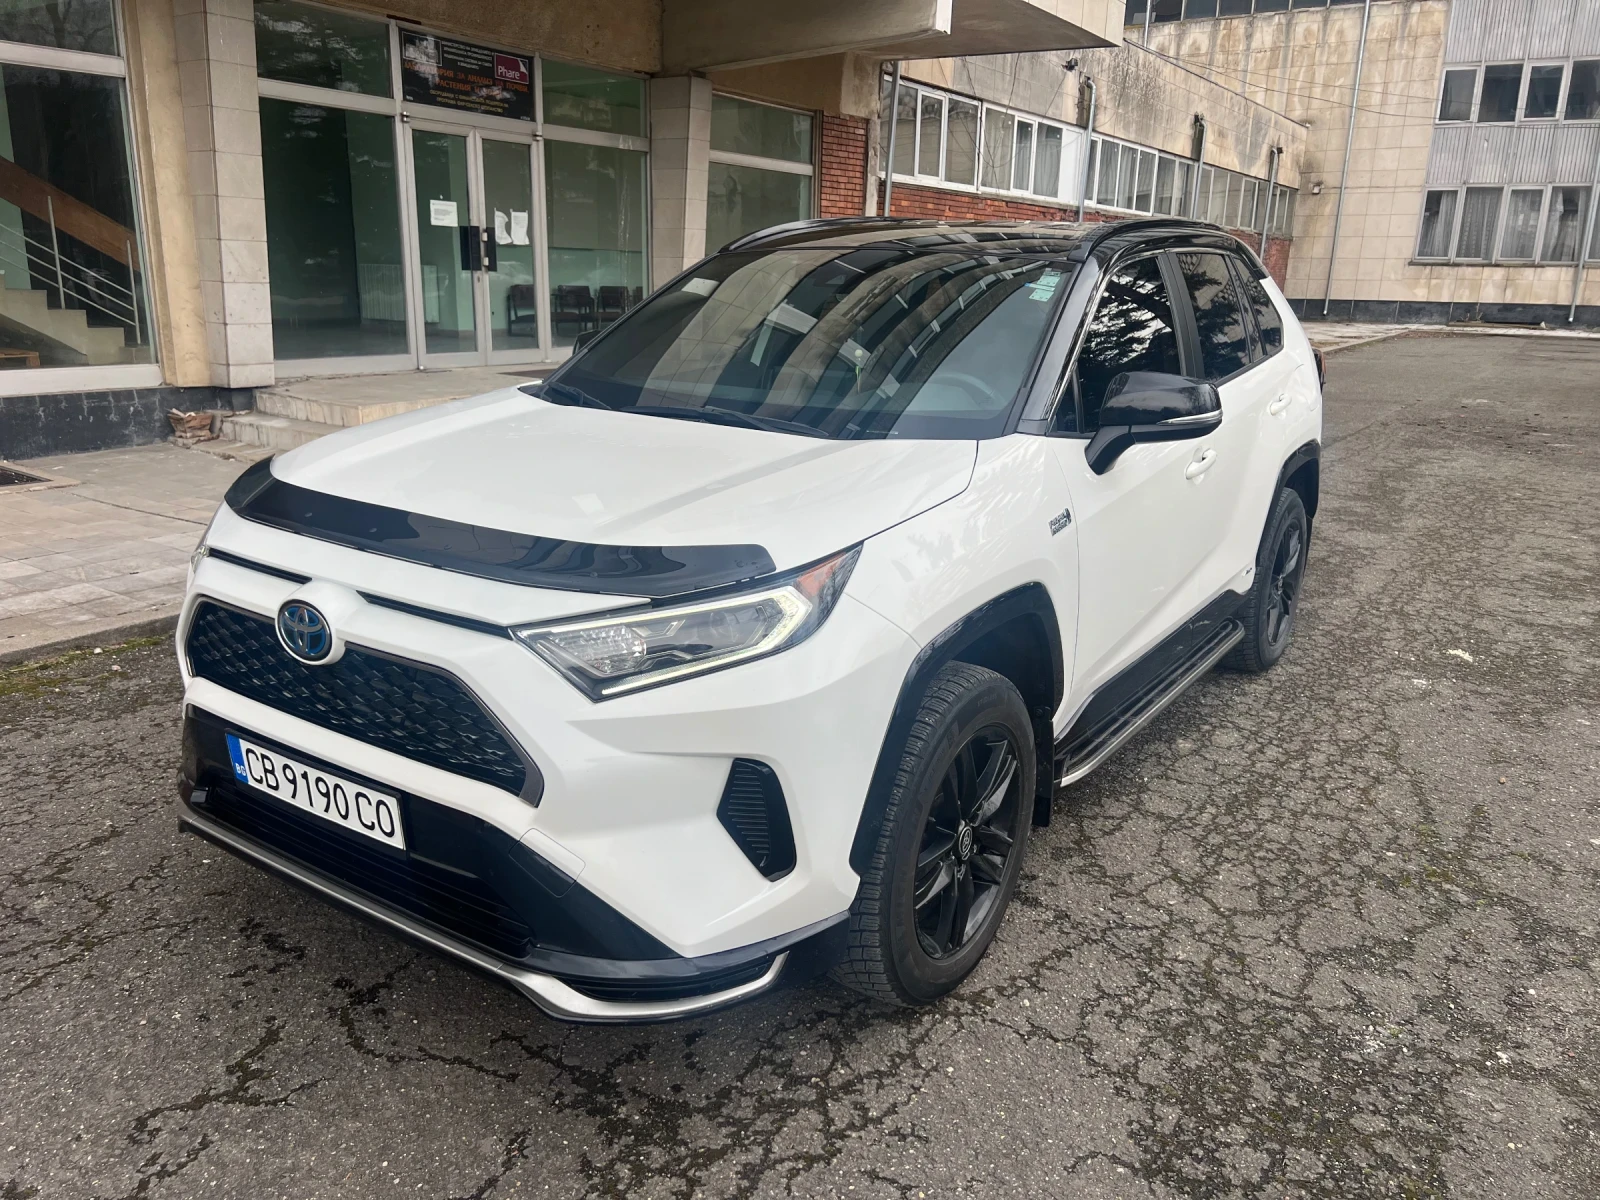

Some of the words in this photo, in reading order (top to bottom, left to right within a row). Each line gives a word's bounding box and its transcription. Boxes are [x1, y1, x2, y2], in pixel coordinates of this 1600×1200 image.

[497, 65, 520, 80] Phare
[235, 763, 247, 777] BG
[245, 747, 280, 791] CB
[282, 763, 350, 820] 9190
[355, 791, 395, 838] CO
